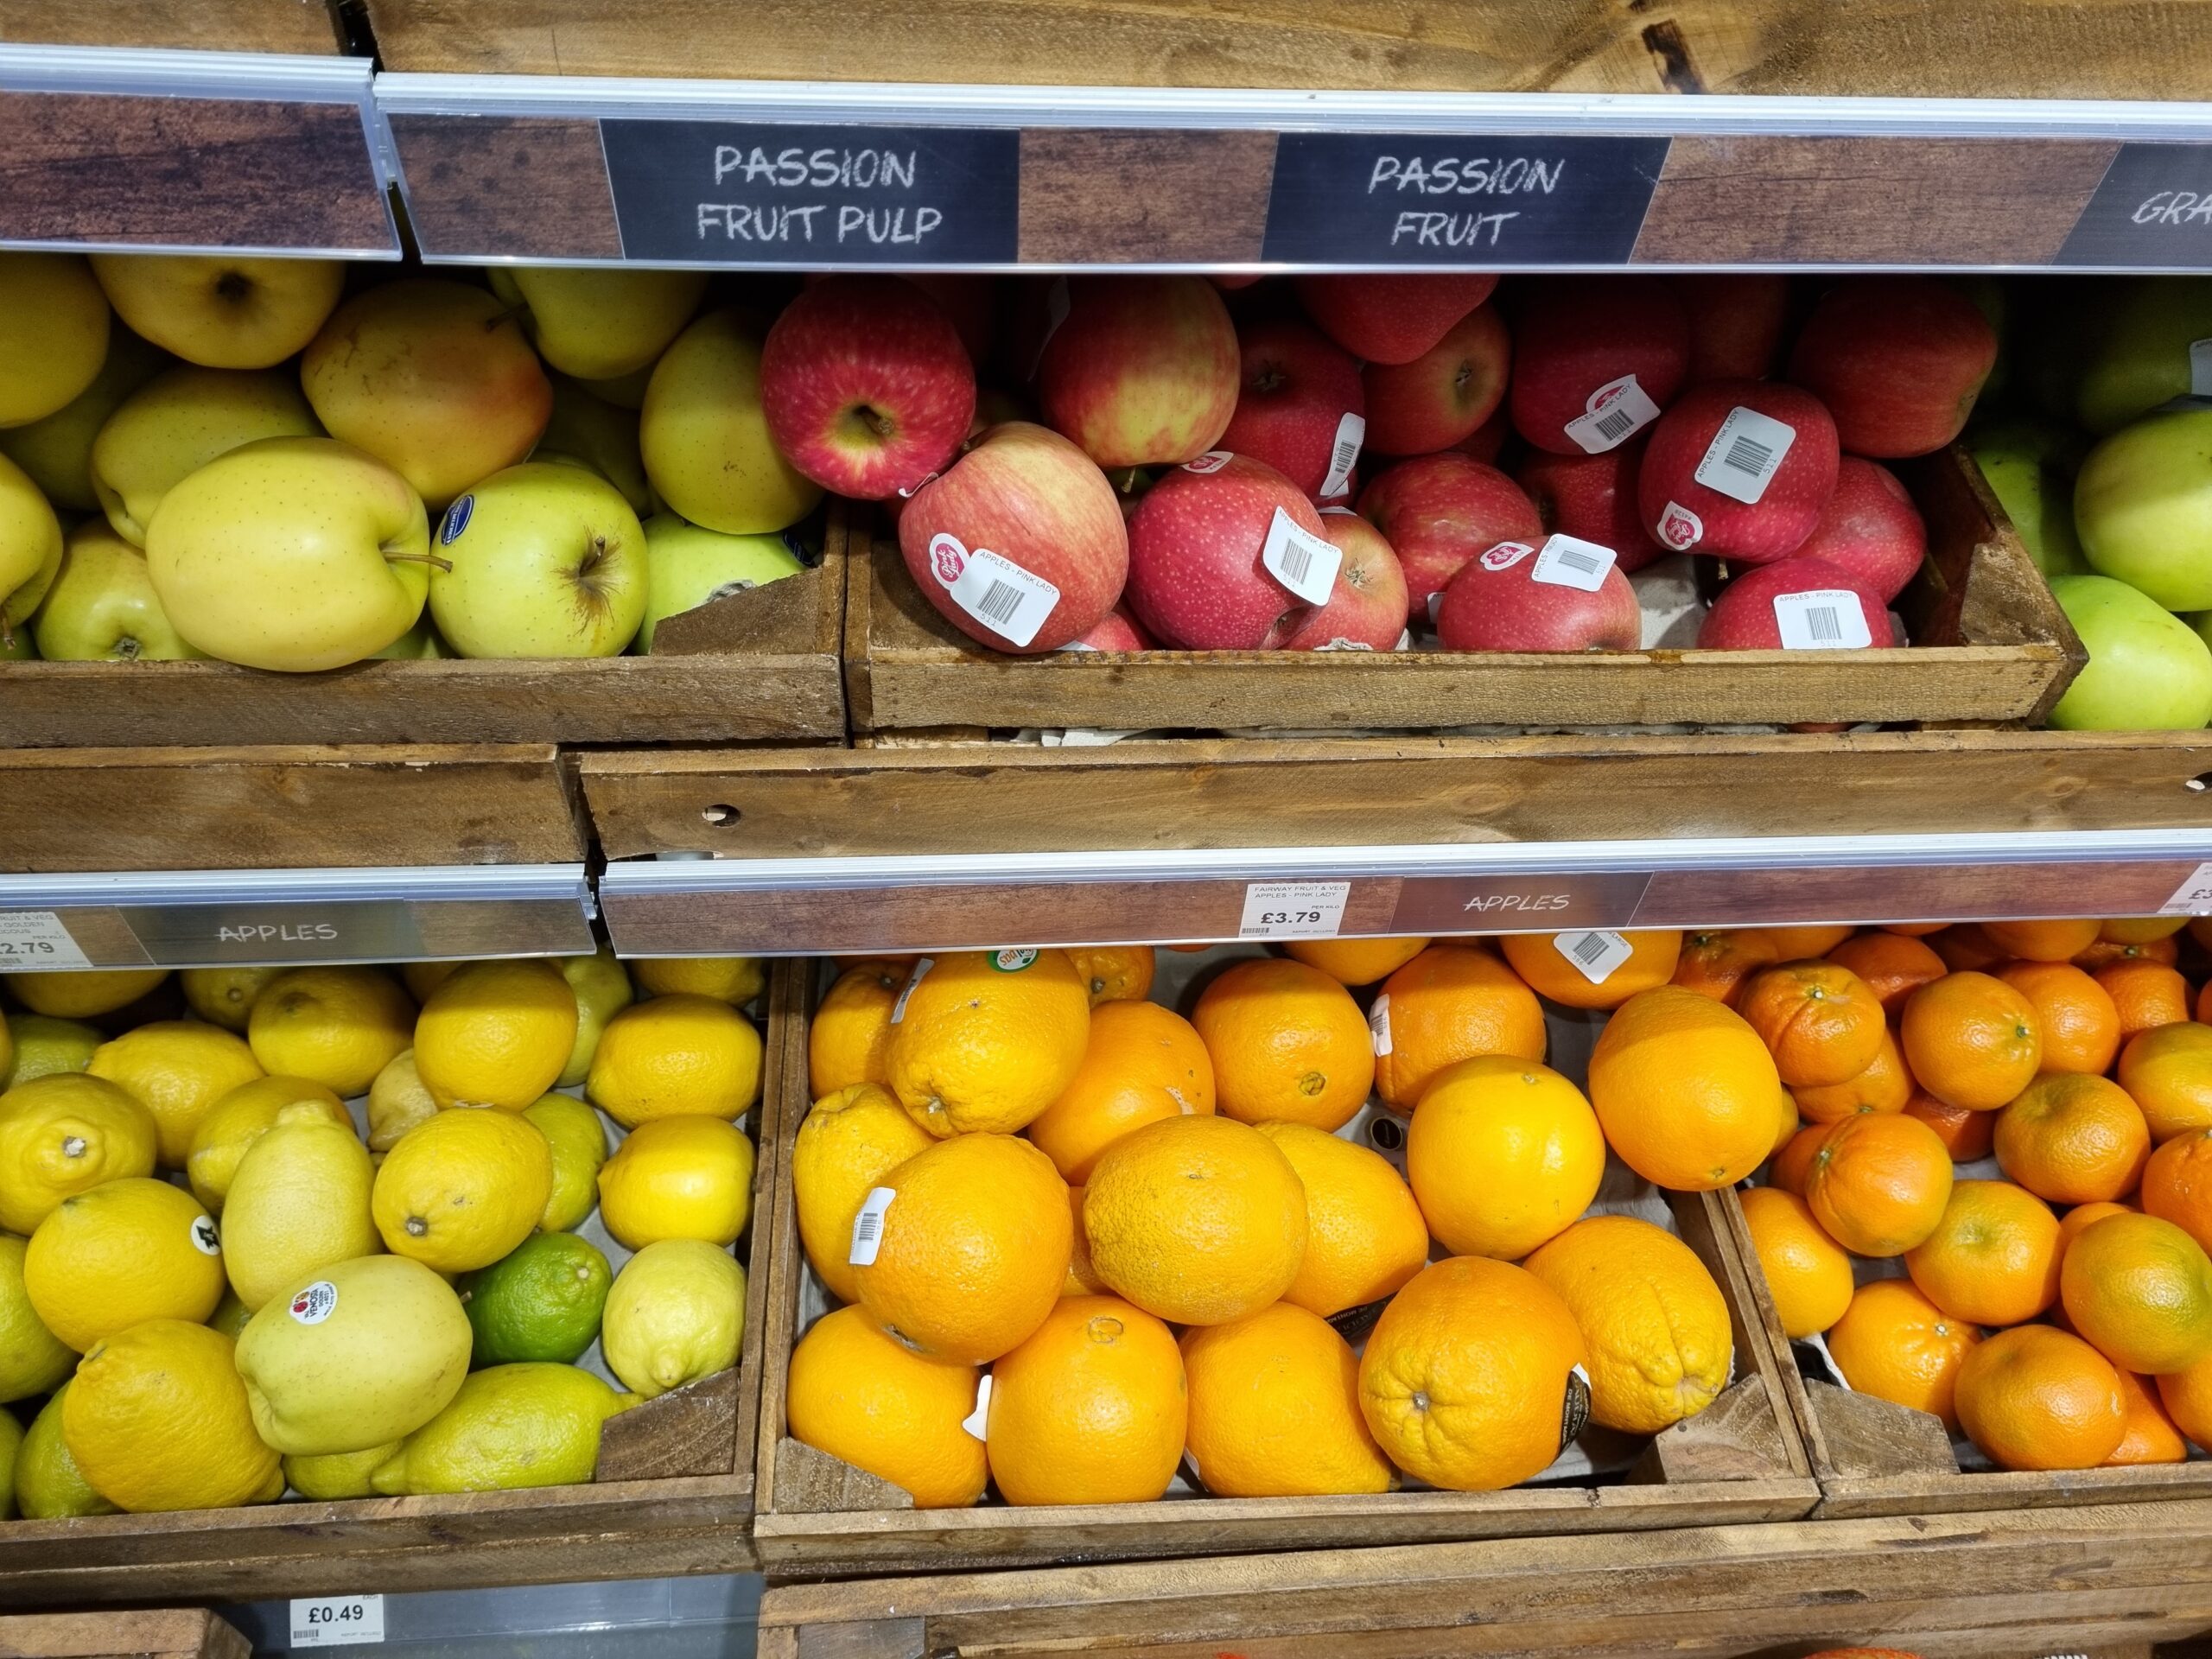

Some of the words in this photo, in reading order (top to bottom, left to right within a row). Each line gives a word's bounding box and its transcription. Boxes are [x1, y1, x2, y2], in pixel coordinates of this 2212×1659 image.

[714, 145, 917, 188] PASSION
[1367, 156, 1566, 194] PASSION
[697, 203, 827, 242] FRUIT
[837, 206, 944, 244] PULP
[2130, 191, 2212, 225] GRA
[1390, 211, 1522, 246] FRUIT
[1568, 413, 1595, 429] APPLES
[1599, 399, 1616, 412] PINK
[1616, 383, 1631, 401] LADY
[1697, 449, 1716, 478] APPLES
[1715, 427, 1728, 445] PINK
[1727, 410, 1740, 429] LADY
[1764, 458, 1777, 474] 511
[1278, 509, 1298, 532] APPLES
[1301, 532, 1319, 545] PINK
[1319, 543, 1339, 555] LADY
[937, 548, 950, 575] Pink
[947, 548, 960, 578] Lady
[979, 551, 1011, 571] APPLES
[1015, 569, 1035, 584] PINK
[1035, 578, 1058, 595] LADY
[1779, 594, 1810, 602] APPLES
[979, 613, 996, 627] 511
[1261, 911, 1321, 924] £3.79
[1463, 894, 1571, 912] APPLES
[214, 923, 339, 944] APPLES
[309, 1287, 319, 1318] VENOSTA
[308, 1605, 364, 1624] £0.49
